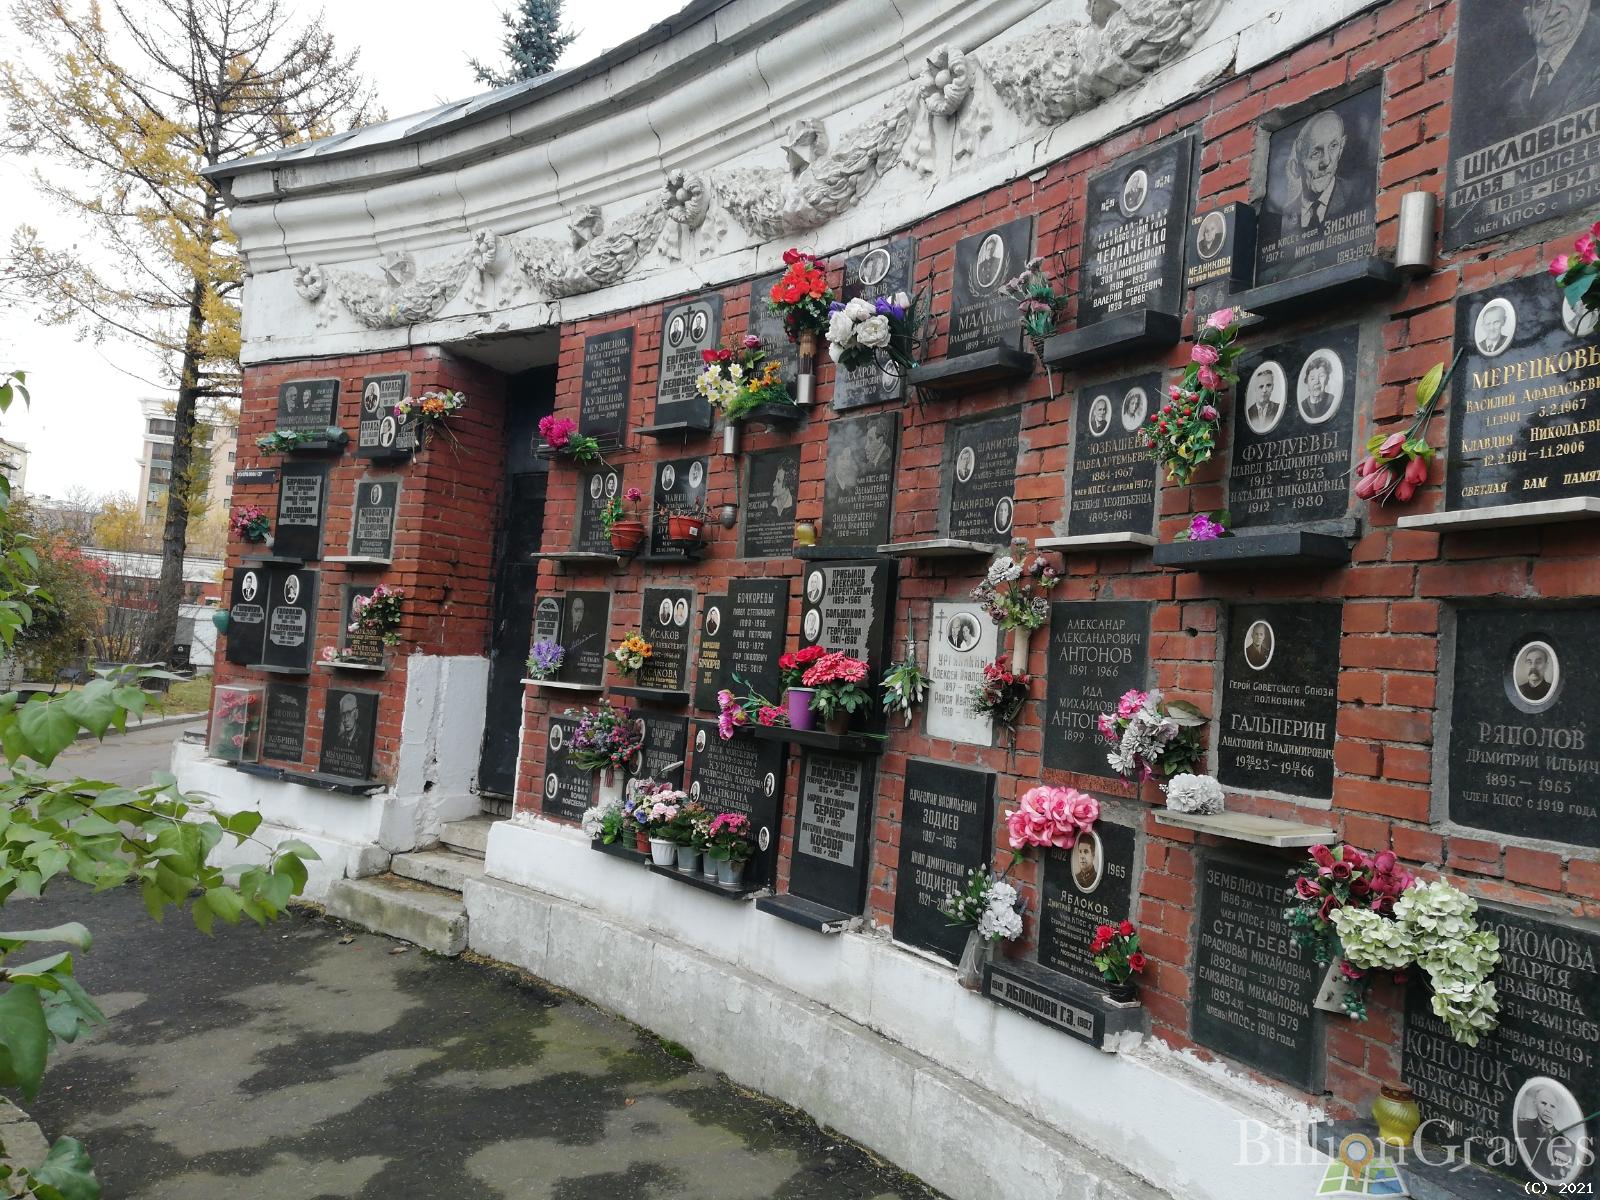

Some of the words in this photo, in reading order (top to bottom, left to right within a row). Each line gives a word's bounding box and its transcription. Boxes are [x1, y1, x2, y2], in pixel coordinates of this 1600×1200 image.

[1455, 176, 1503, 206] ИЛЬЯ
[1474, 222, 1499, 234] ЧЛЕН
[1502, 203, 1546, 227] КПСС
[1097, 228, 1166, 265] ЧЕРПАЧЕНКО
[1126, 277, 1163, 297] СЕРГЕЕВИЧ
[1466, 392, 1516, 413] ВАСИЛИЙ
[1242, 430, 1339, 461] ФУРДУЕВЫ
[1462, 434, 1514, 453] КЛАВДИЯ
[1266, 449, 1348, 472] ВЛАДИМИРОВИЧ
[1231, 487, 1273, 502] НАТАЛИЯ
[1277, 478, 1346, 498] НИКОЛАЕВНА
[1250, 474, 1272, 487] 1912
[1462, 481, 1508, 497] СВЕТЛАЯ
[1523, 476, 1548, 490] ВАМ
[1248, 501, 1270, 513] 1912
[1292, 495, 1324, 509] 1980
[1067, 619, 1126, 631] АЛЕКСАНДР
[1055, 632, 1140, 645] АЛЕКСАНДРОВИЧ
[1059, 646, 1132, 663] АНТОНОВ
[1069, 665, 1087, 676] 1891
[1097, 666, 1119, 677] 1966
[1082, 685, 1103, 697] ИДА
[1254, 694, 1306, 708] ПОЛКОВНИК
[1059, 698, 1119, 713] МИХАЙЛОВН
[1064, 730, 1085, 743] 1899
[1231, 713, 1326, 741] ГАЛЬПЕРИН
[1479, 721, 1585, 750] РЯПОЛОВ
[1266, 740, 1335, 761] ВЛАДИМИРОВИЧ
[1466, 749, 1540, 769] ДИМИТРИЙ
[1546, 756, 1600, 775] ИЛЬИЧ
[1486, 772, 1516, 788] 1895
[1538, 775, 1572, 794] 1965
[1463, 790, 1488, 803] ЧЛЕН
[1493, 793, 1522, 808] КПСС
[1537, 799, 1564, 813] 1919
[923, 808, 959, 831] ЗОДИЕВ
[1107, 861, 1126, 879] 1965
[1061, 889, 1109, 916] ЯБЛОКОВ
[1213, 919, 1302, 961] СТАТЬЕВЫ
[1201, 933, 1248, 960] ПРАСКОВЬЯ
[1251, 949, 1312, 983] МИХАЙЛОВНА
[1502, 953, 1571, 990] МАРИЯ
[1199, 966, 1245, 994] ЕЛИЗАВЕТА
[1248, 983, 1310, 1018] МИХАЙЛОВНА
[1228, 1009, 1250, 1030] КПСС
[1566, 1017, 1600, 1042] 1965
[1405, 1028, 1514, 1092] КОНОНОК
[1547, 1038, 1583, 1063] 1919
[1405, 1057, 1504, 1108] АЛЕКСАНДР
